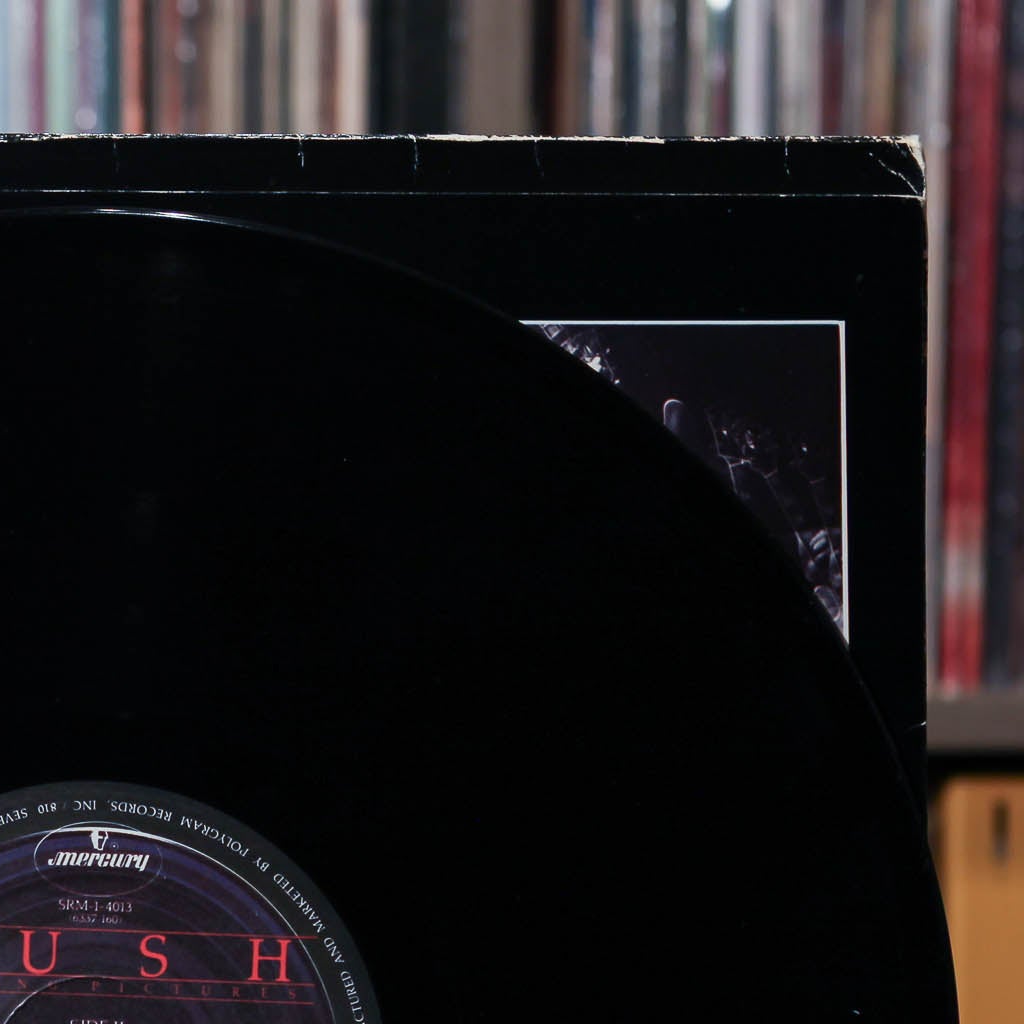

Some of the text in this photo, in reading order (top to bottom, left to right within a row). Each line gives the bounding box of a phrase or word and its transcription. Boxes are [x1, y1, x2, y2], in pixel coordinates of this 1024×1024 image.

[37, 802, 57, 815] 810
[73, 799, 97, 811] INC
[179, 815, 250, 857] POLYGRAM
[48, 851, 150, 872] mercury
[252, 856, 271, 873] BY
[58, 898, 132, 913] SRM-1-4013
[273, 873, 326, 934] MARKETED
[323, 937, 345, 963] AND
